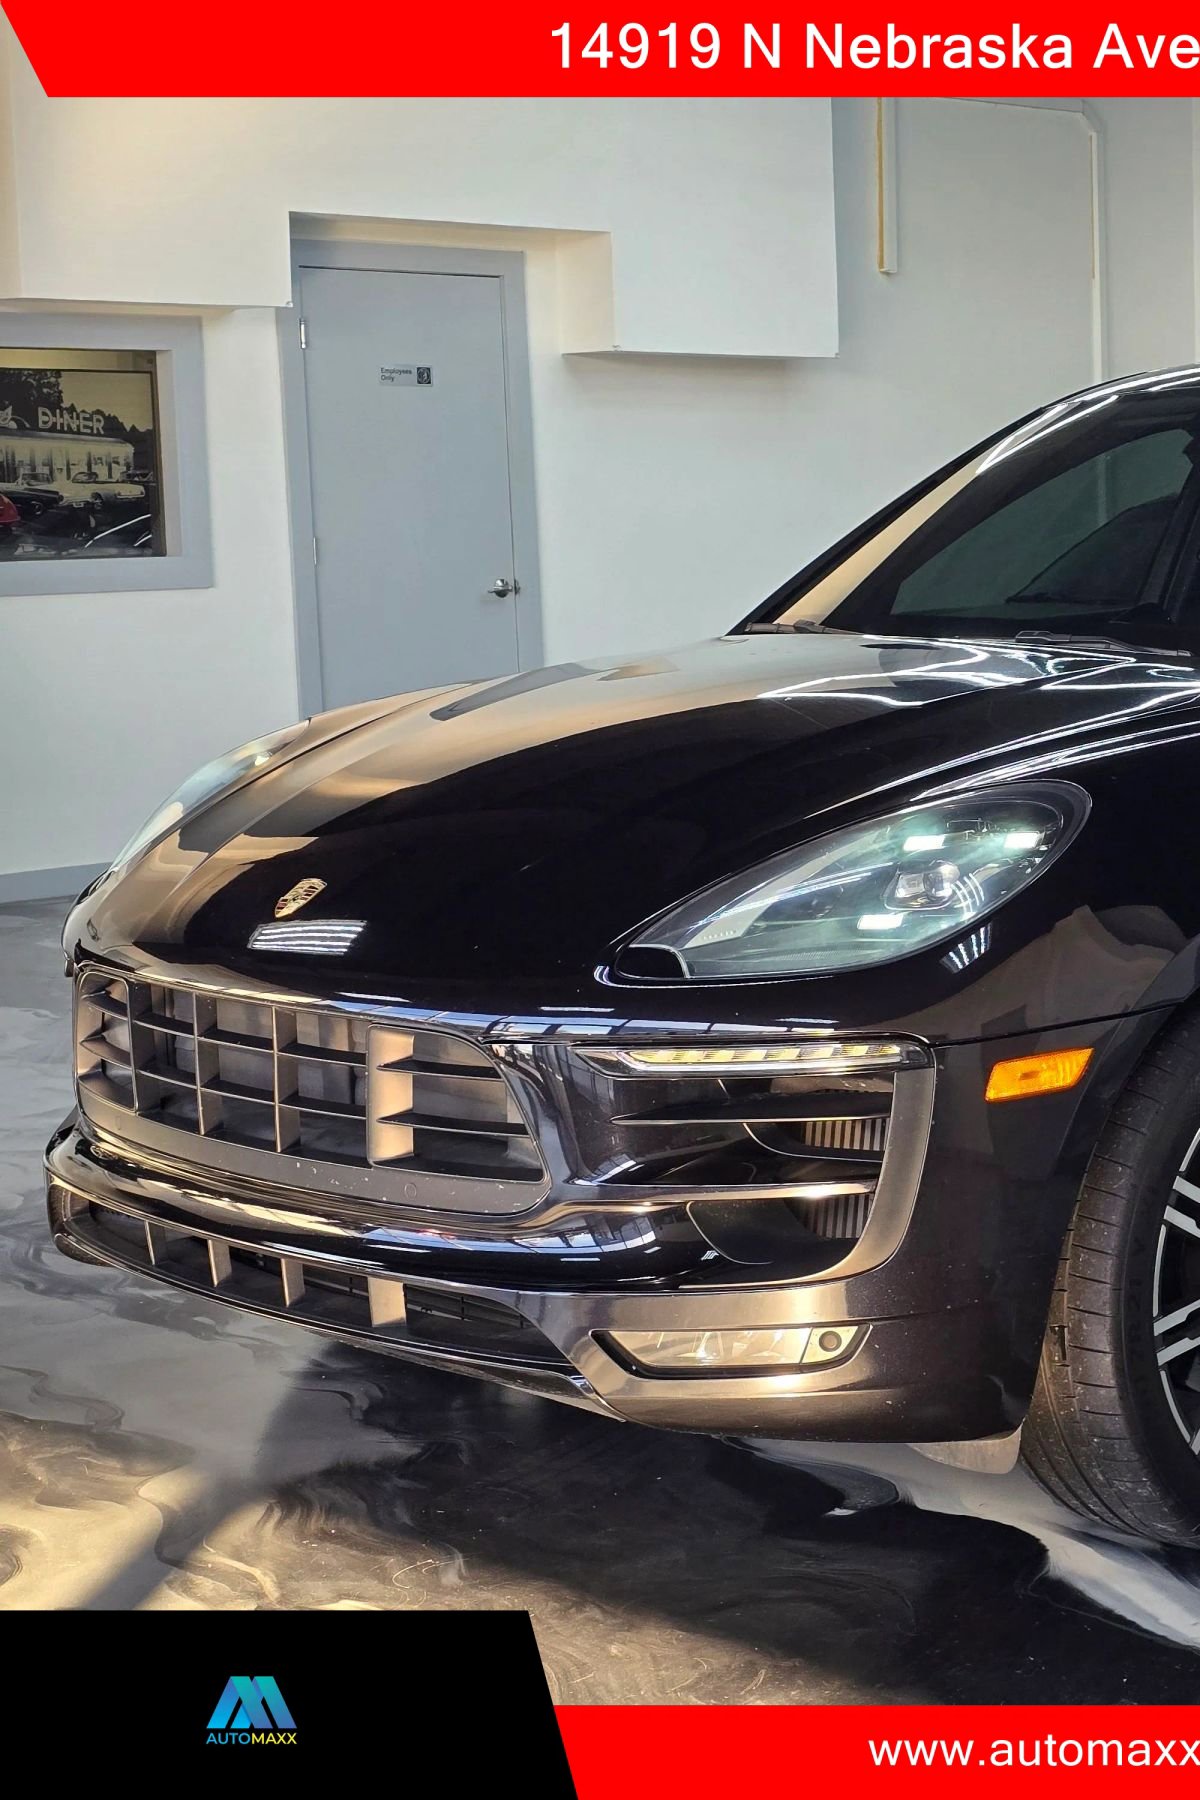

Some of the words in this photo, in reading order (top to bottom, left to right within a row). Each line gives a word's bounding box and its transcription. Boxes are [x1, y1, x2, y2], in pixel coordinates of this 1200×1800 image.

[380, 367, 412, 376] Employees
[380, 374, 395, 382] Only
[37, 406, 104, 434] DINER
